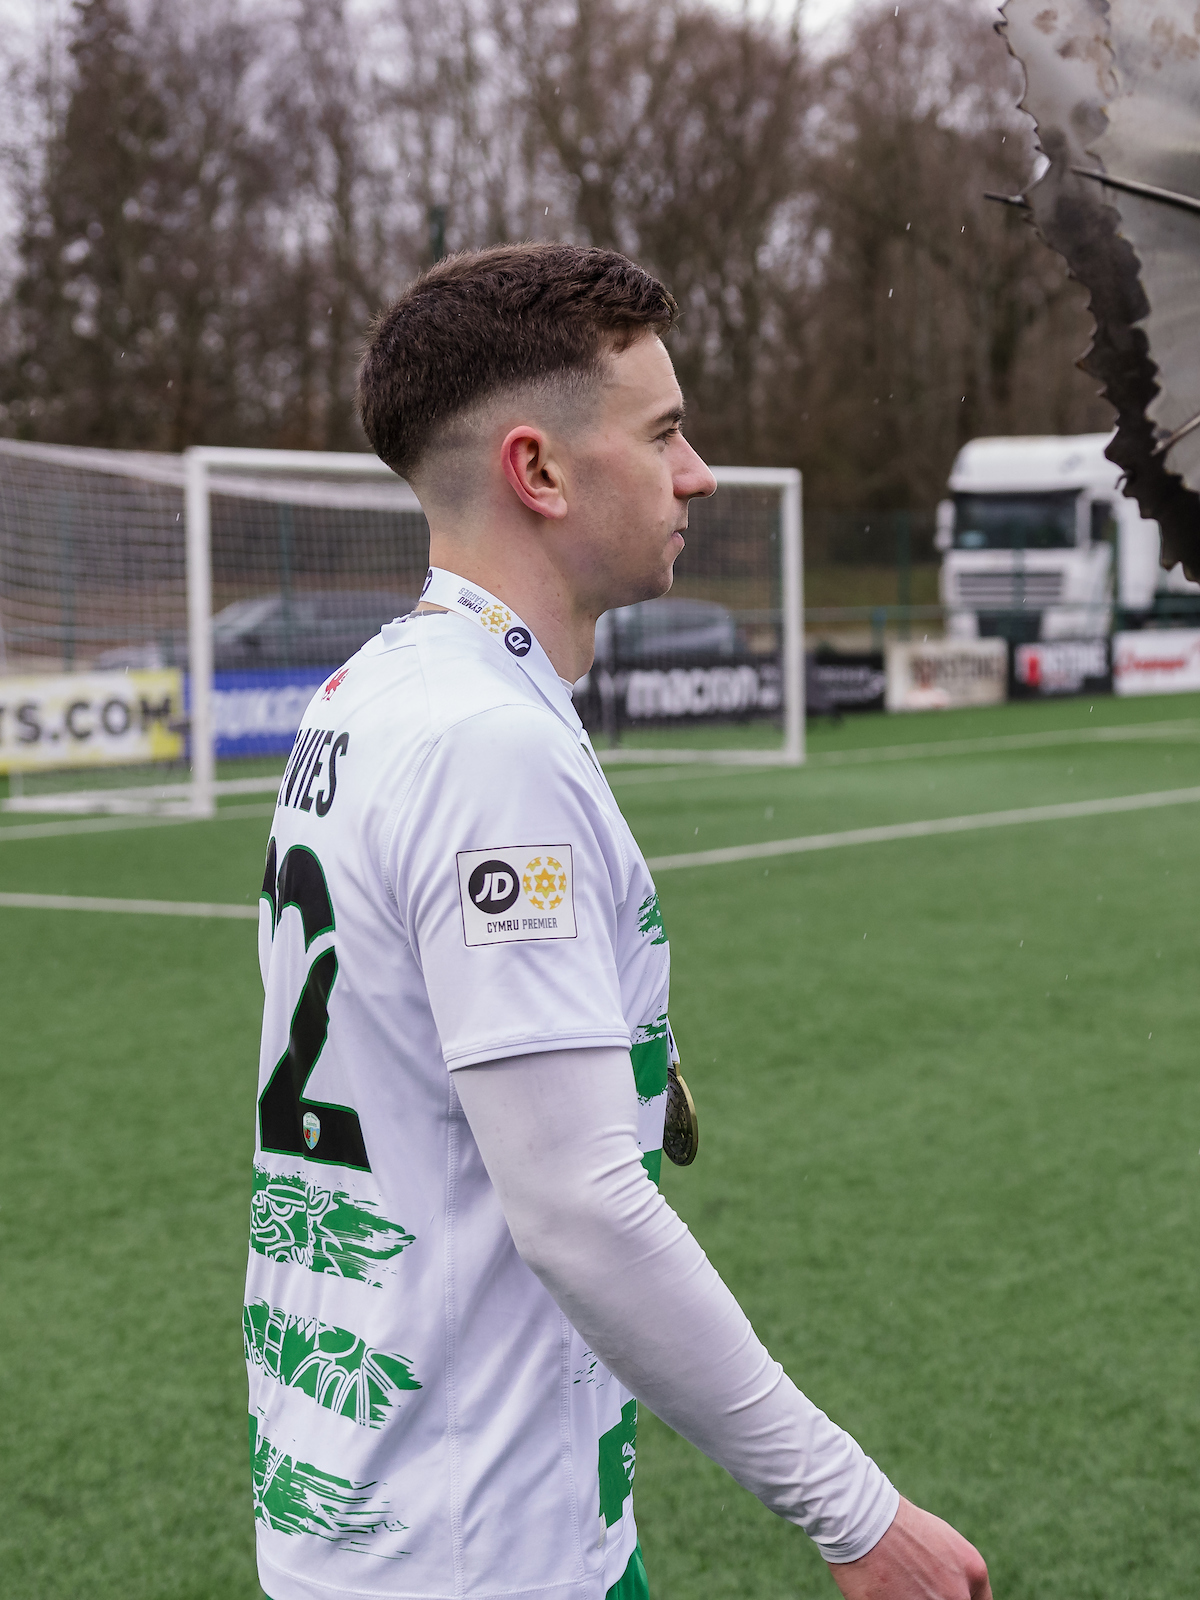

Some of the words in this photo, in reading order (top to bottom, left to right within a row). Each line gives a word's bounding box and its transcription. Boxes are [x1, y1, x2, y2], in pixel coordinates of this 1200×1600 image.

[457, 596, 483, 613] CYMRU
[458, 587, 489, 608] LEAGUES
[508, 631, 529, 651] JD
[475, 871, 514, 903] JD
[487, 919, 519, 933] CYMRU
[522, 917, 558, 930] PREMIER
